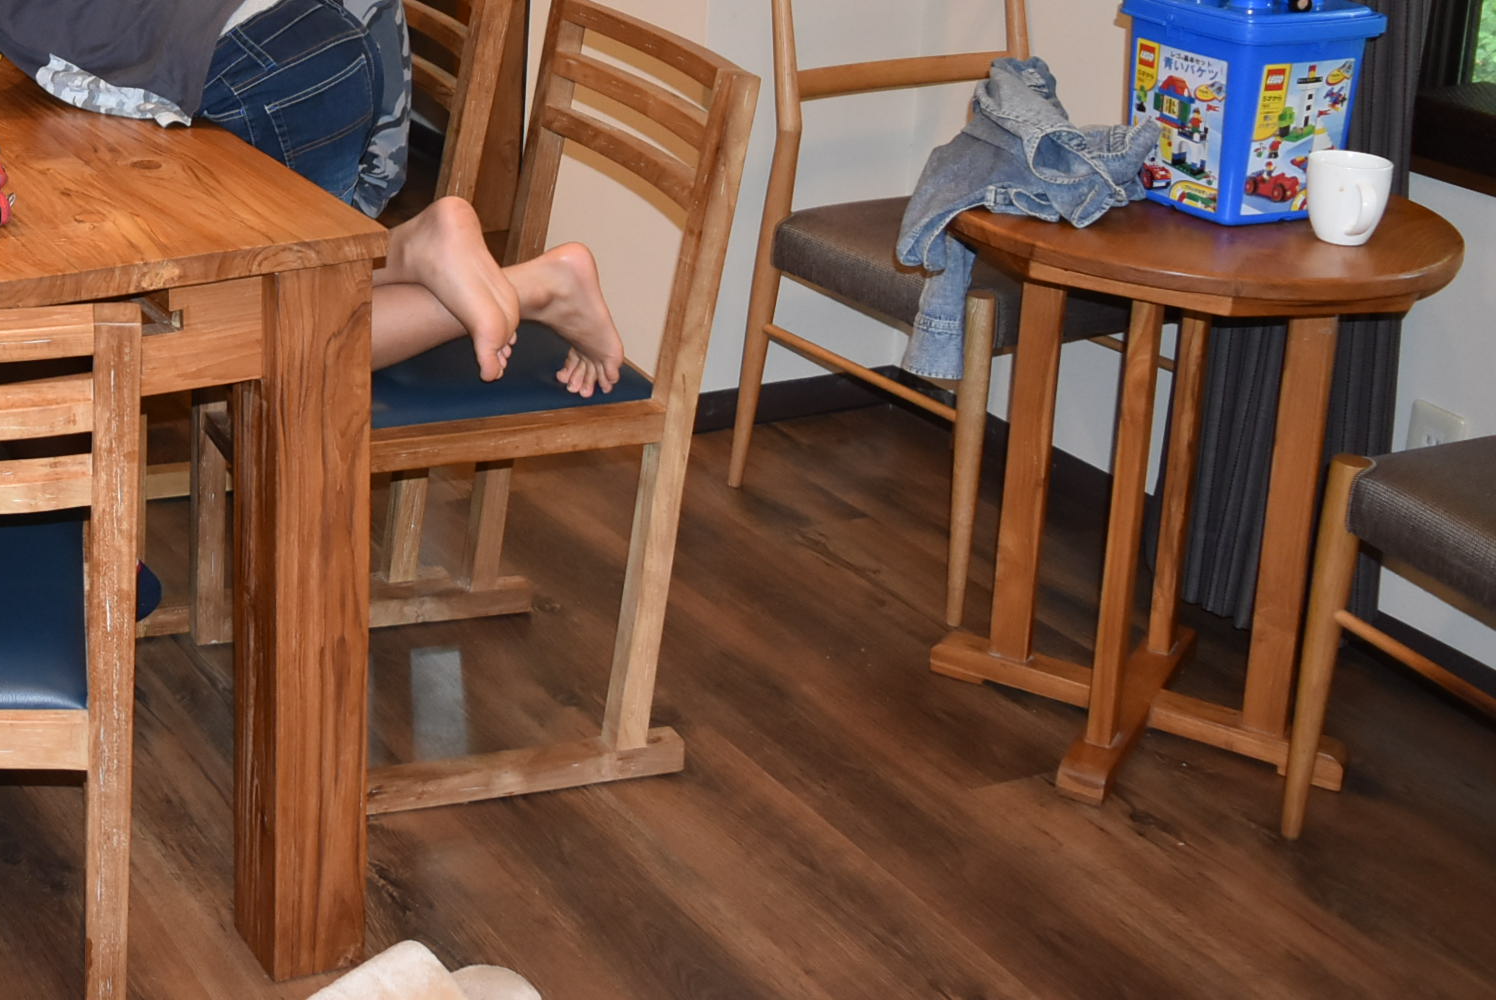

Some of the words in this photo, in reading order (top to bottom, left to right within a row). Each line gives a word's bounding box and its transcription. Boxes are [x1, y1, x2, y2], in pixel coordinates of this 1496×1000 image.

[1164, 56, 1218, 81] 青いバケツ
